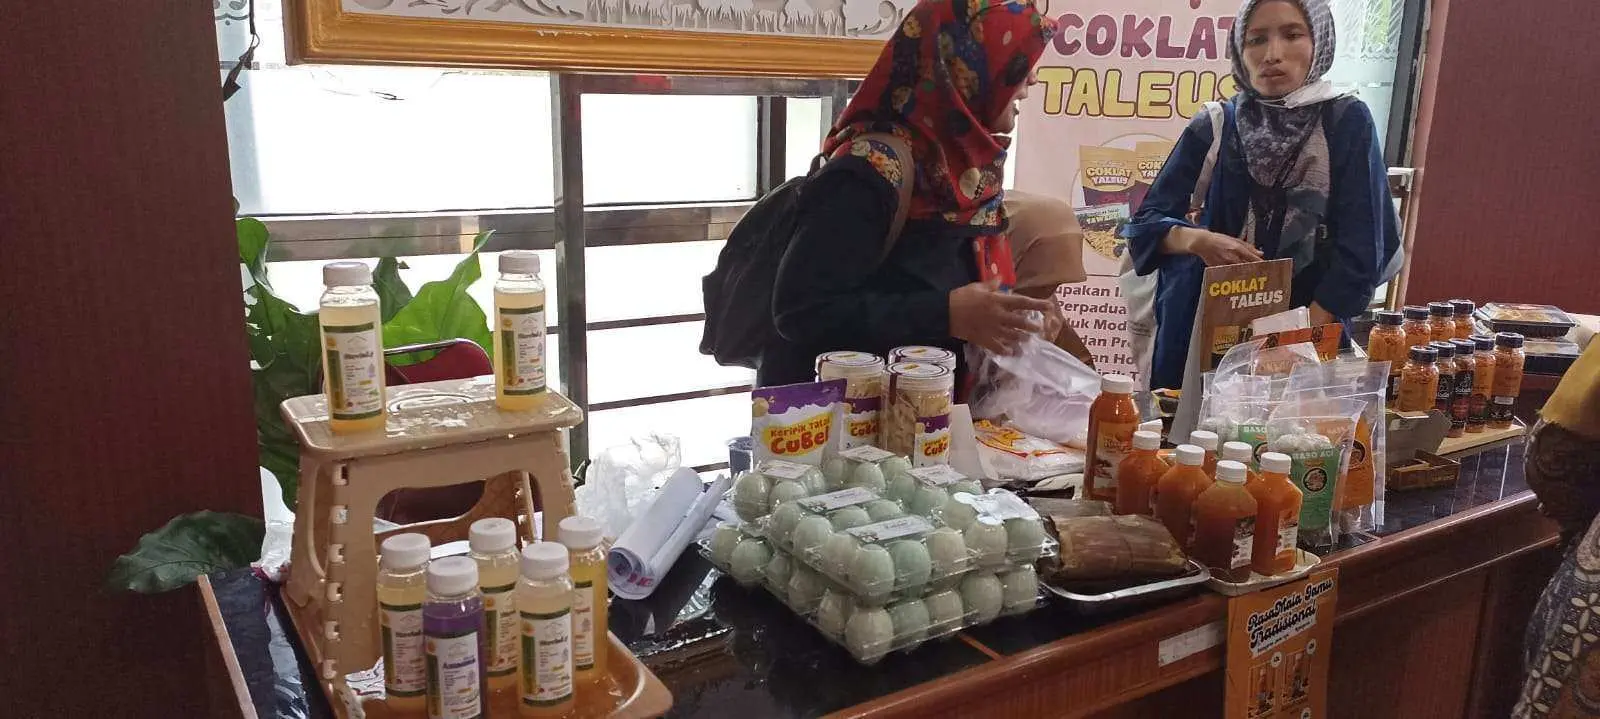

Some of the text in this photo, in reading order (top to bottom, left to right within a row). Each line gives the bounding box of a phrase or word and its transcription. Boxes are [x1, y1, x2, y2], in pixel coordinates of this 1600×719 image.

[1053, 14, 1236, 60] COKLAT
[1038, 67, 1241, 118] TALEUS
[1209, 276, 1267, 297] COKLAT
[1230, 289, 1284, 310] TALEUS
[1304, 578, 1334, 601] Jamu
[1250, 599, 1316, 649] Tradisional
